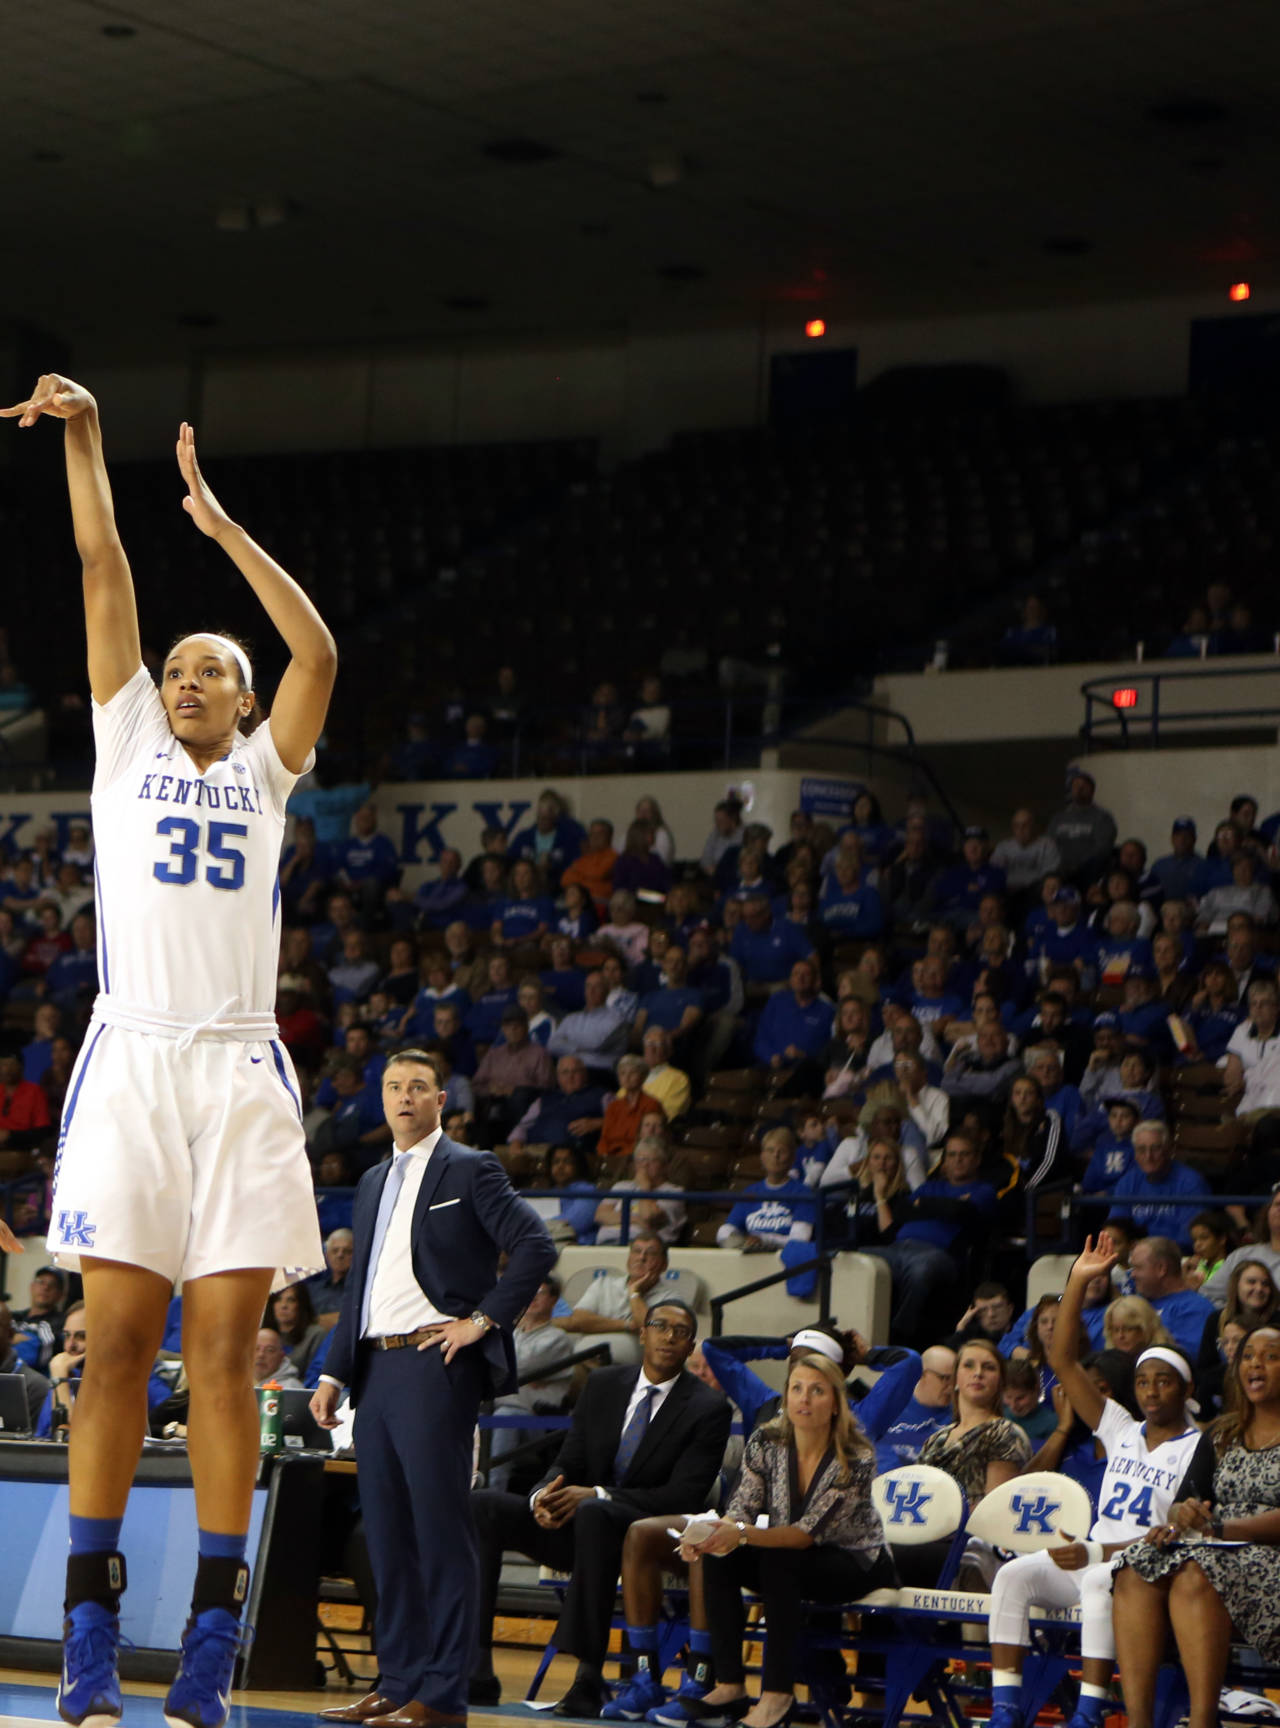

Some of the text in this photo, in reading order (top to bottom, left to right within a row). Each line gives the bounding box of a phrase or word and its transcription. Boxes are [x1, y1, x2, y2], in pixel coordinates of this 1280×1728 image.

[153, 816, 248, 891] 35
[58, 1210, 96, 1248] UK
[1109, 1456, 1178, 1490] KENTUCKY
[885, 1479, 933, 1524] UK
[1010, 1494, 1061, 1535] UK
[1102, 1481, 1153, 1527] 24
[913, 1594, 986, 1613] KENTUCKY
